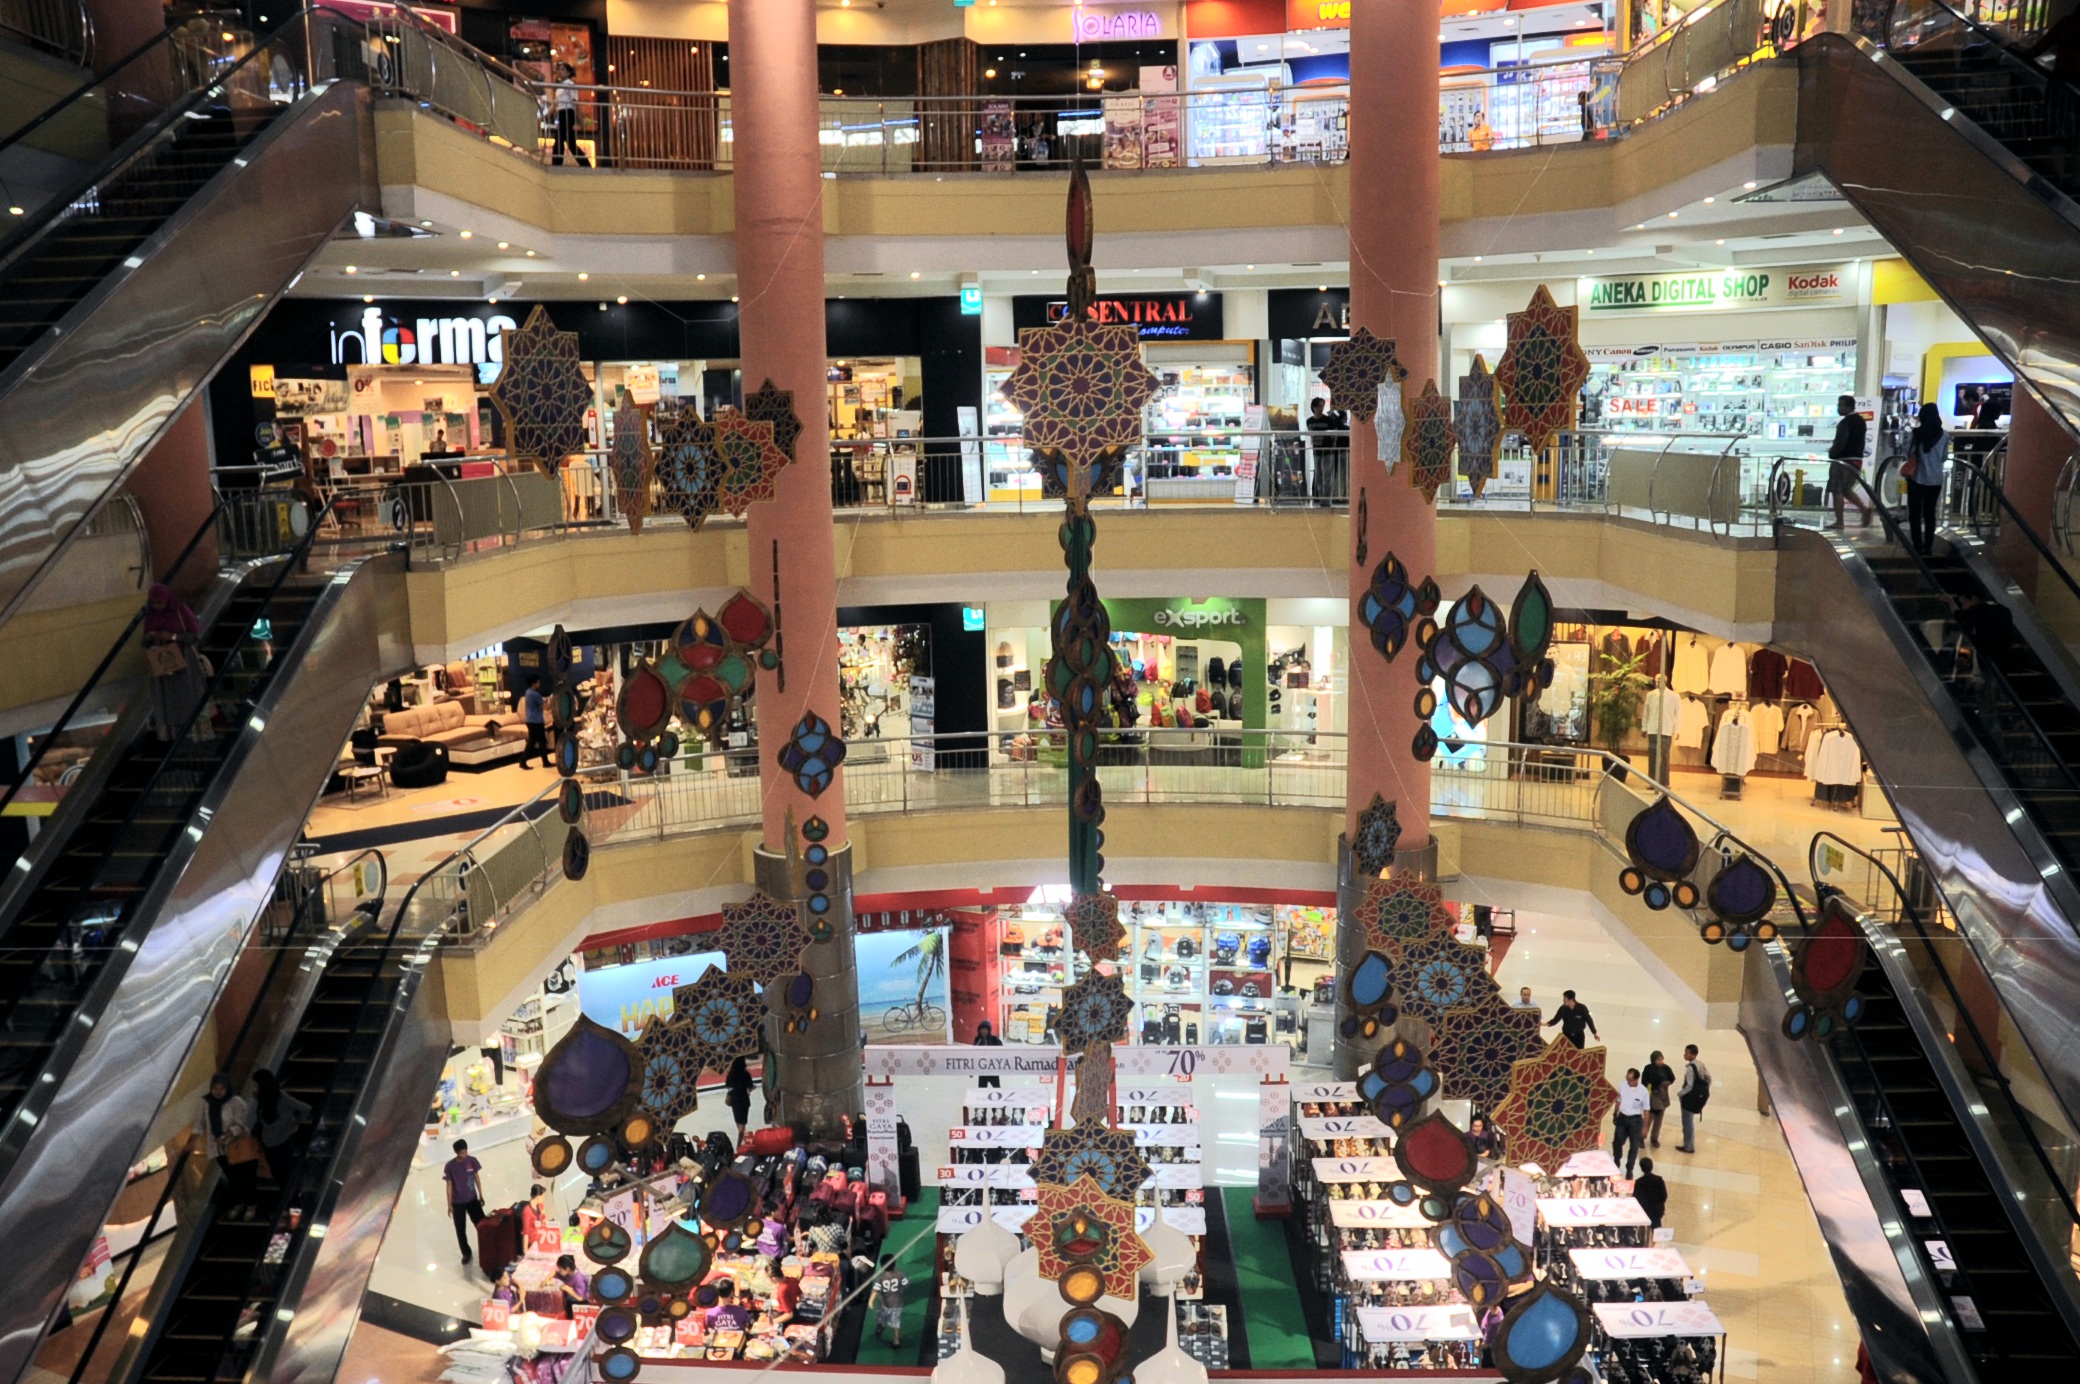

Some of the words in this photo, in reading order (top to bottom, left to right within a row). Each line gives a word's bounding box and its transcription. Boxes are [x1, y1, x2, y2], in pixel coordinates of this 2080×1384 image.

[1073, 3, 1157, 44] SOLARIA
[1590, 281, 1646, 304] ANEKA
[1651, 278, 1716, 301] DIGITAL
[1723, 274, 1770, 298] SHOP
[1788, 274, 1839, 290] Kodak
[329, 307, 516, 365] informa
[1131, 323, 1191, 337] omputer
[1760, 342, 1792, 350] CASIO
[1794, 340, 1828, 348] SanDisk
[1609, 397, 1657, 413] SALE
[651, 974, 680, 989] ACE
[945, 1058, 975, 1070] FITRI
[978, 1058, 1011, 1070] GAYA
[1167, 1049, 1206, 1075] 70%
[951, 1130, 963, 1138] 50
[940, 1170, 951, 1178] 30
[1617, 1182, 1630, 1190] 50
[1023, 1190, 1036, 1198] 50
[1187, 1192, 1200, 1200] 50
[537, 1229, 557, 1245] 70
[882, 1279, 899, 1293] 92
[483, 1308, 505, 1323] 70
[574, 1315, 596, 1331] 70
[677, 1320, 699, 1336] 50
